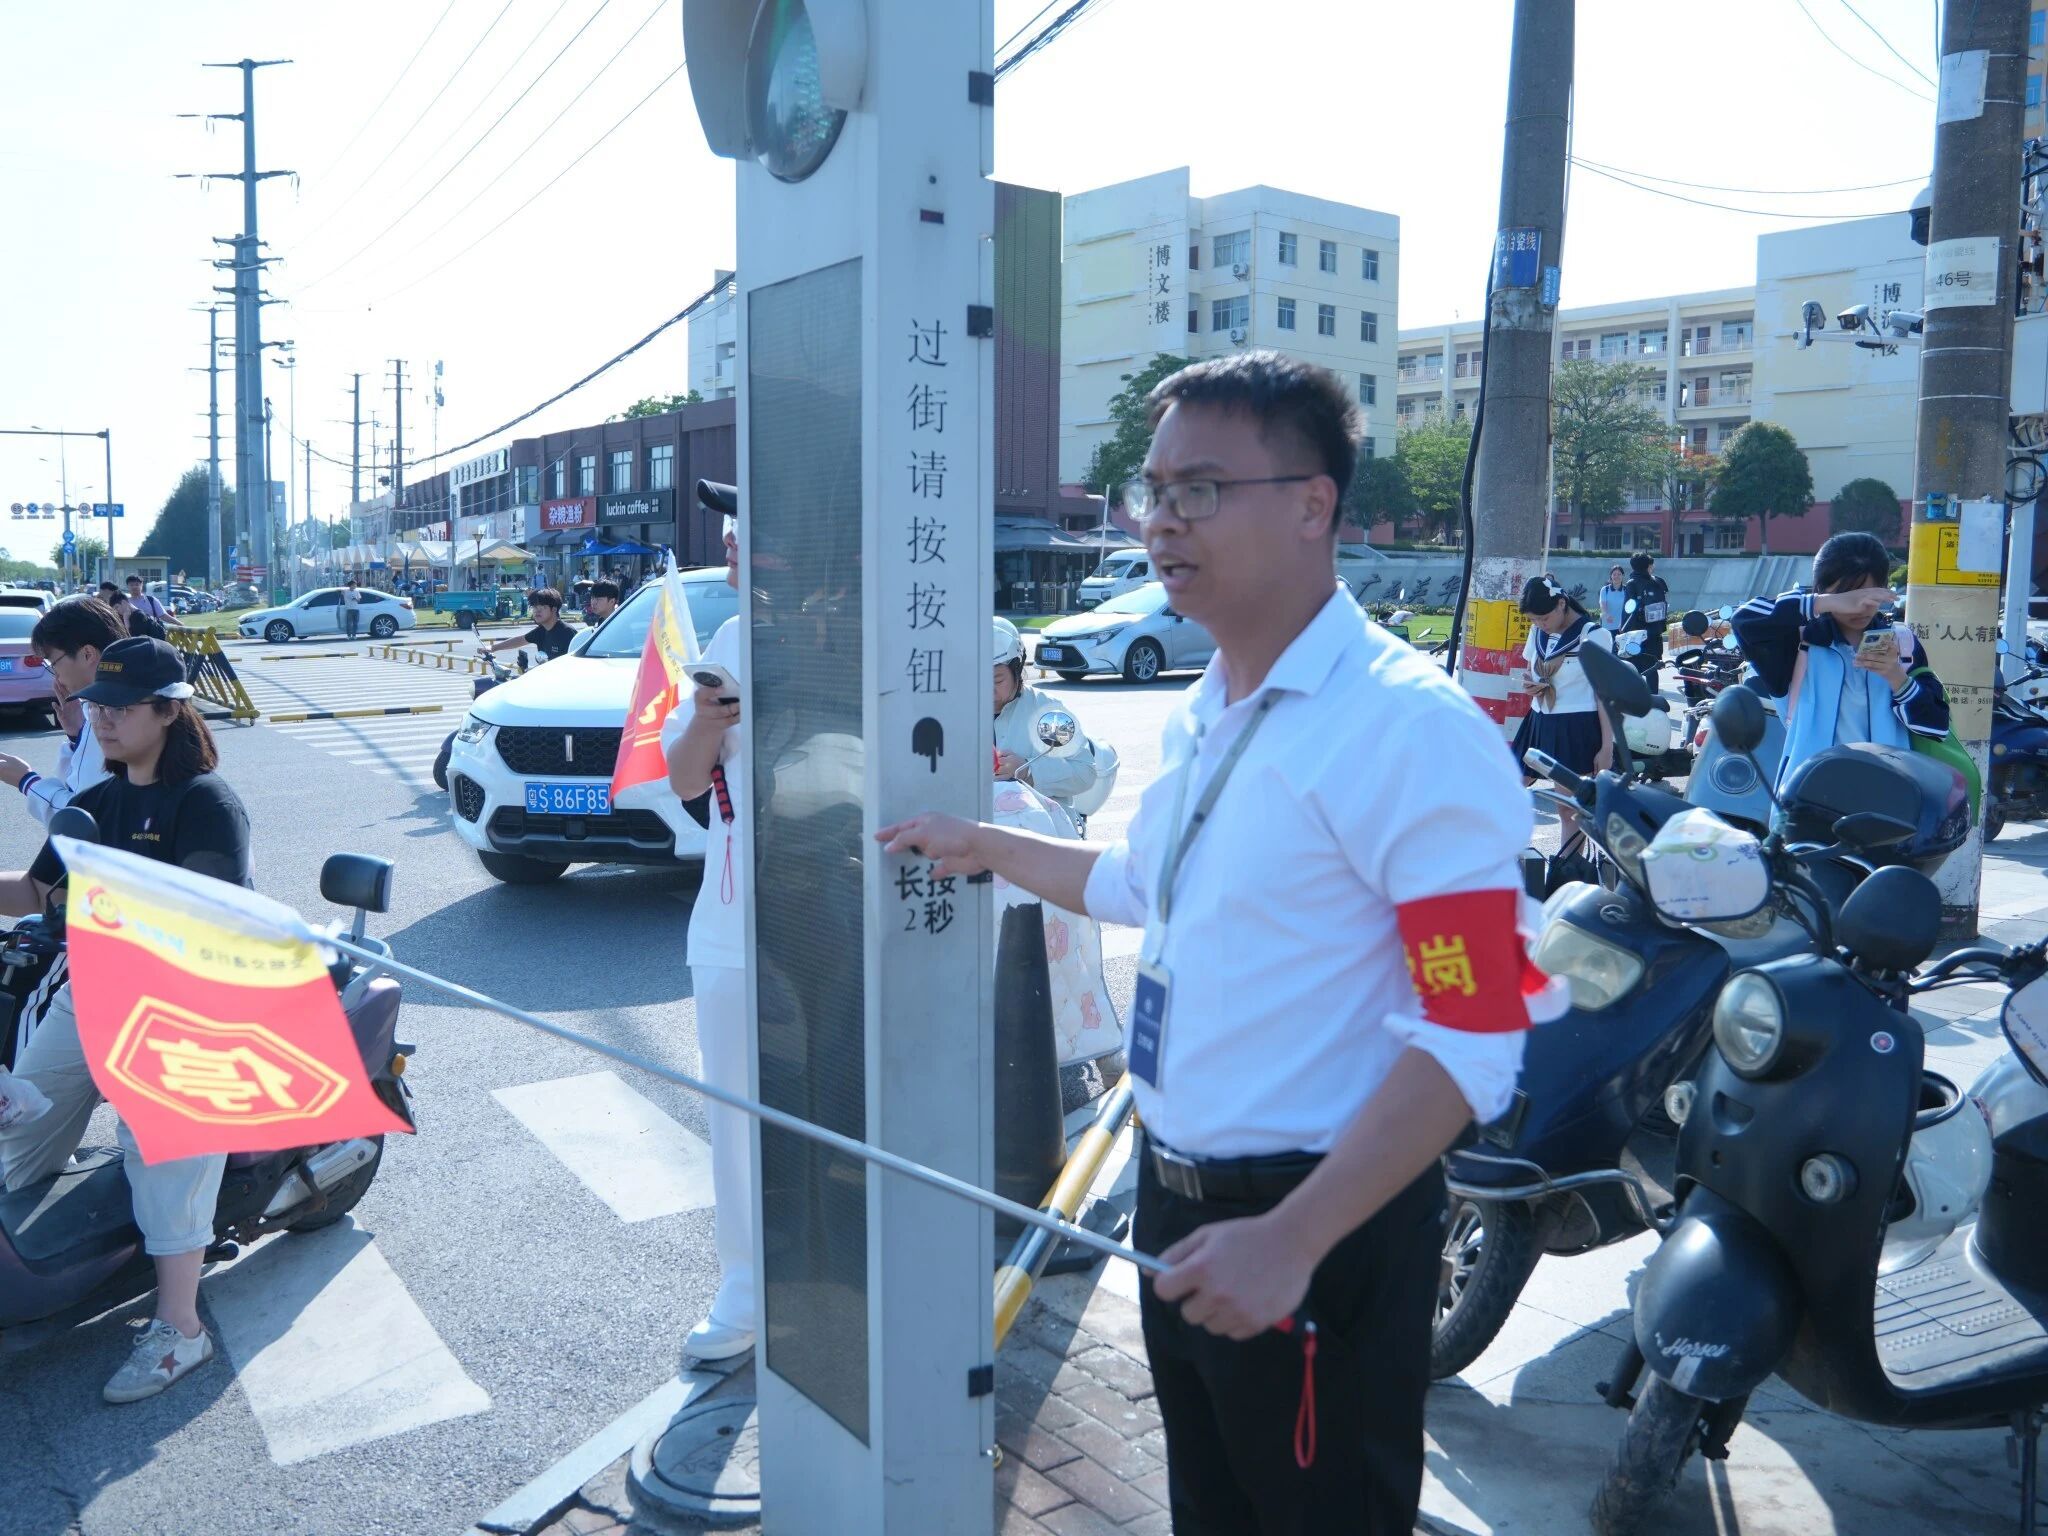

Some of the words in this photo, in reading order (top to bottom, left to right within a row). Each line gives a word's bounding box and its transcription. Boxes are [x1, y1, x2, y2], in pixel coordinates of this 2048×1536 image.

[1155, 245, 1171, 324] 博文楼
[1936, 271, 1972, 287] 46号
[606, 501, 626, 516] luckin
[627, 498, 649, 514] coffee
[906, 319, 948, 695] 过街请按按钮
[528, 788, 608, 810] 粤S·86F85
[894, 863, 956, 900] 长按
[904, 898, 954, 934] 2秒
[1403, 934, 1477, 996] 岗
[1661, 1337, 1730, 1357] Horses
